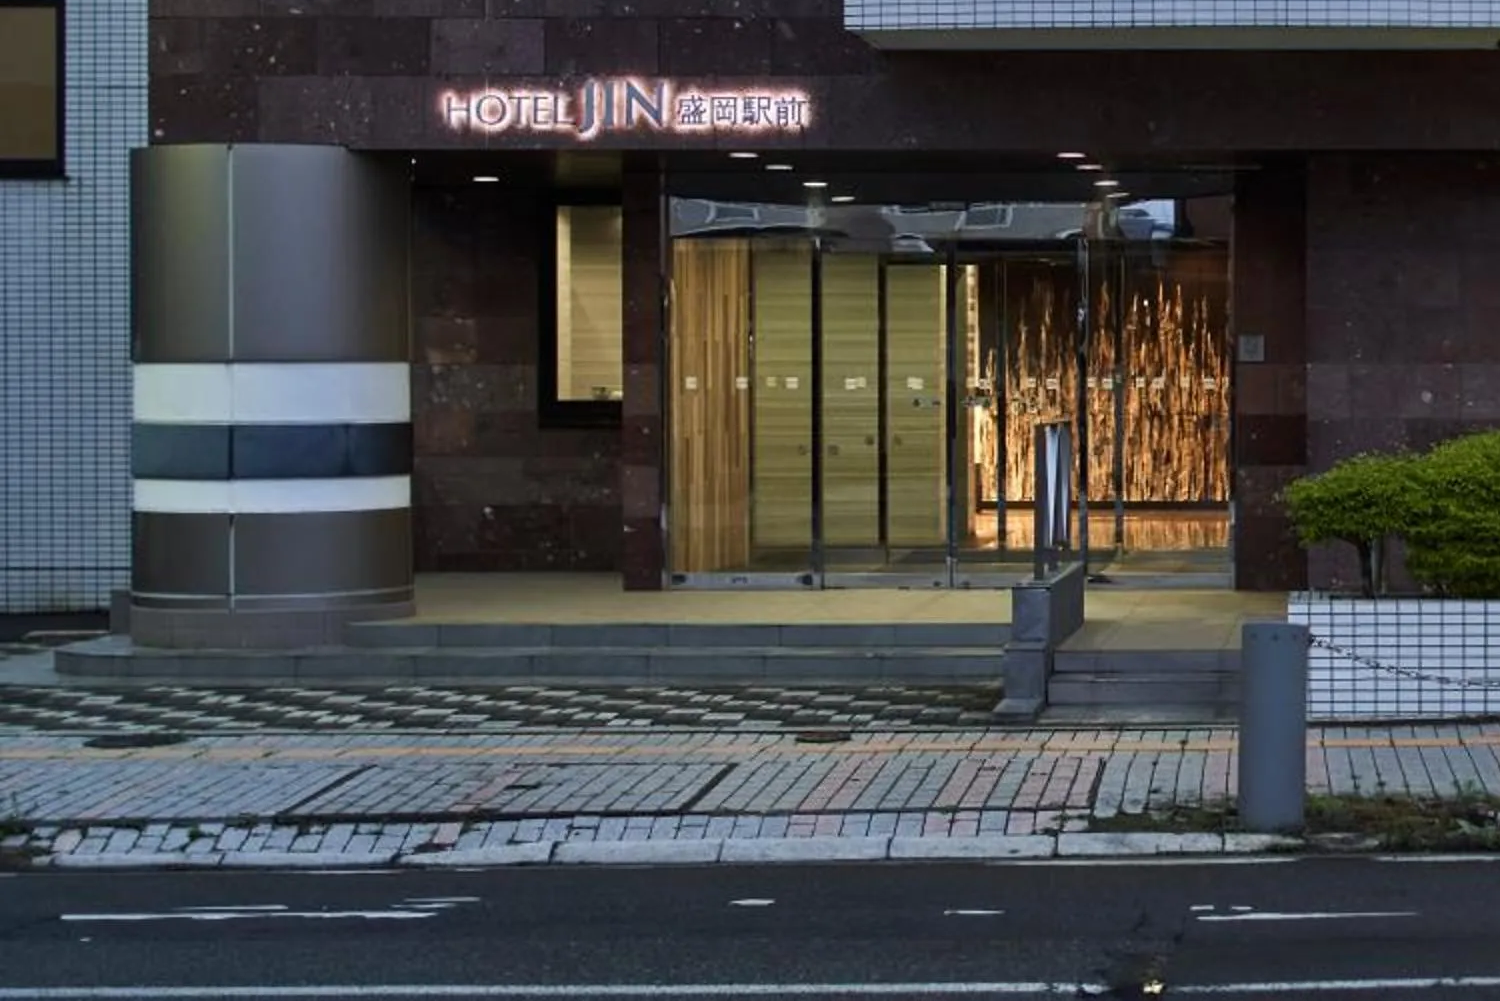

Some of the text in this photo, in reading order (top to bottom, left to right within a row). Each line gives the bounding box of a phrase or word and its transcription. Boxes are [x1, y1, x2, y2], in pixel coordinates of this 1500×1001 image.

[446, 79, 806, 133] HOTEL JIN 盛岡駅前
